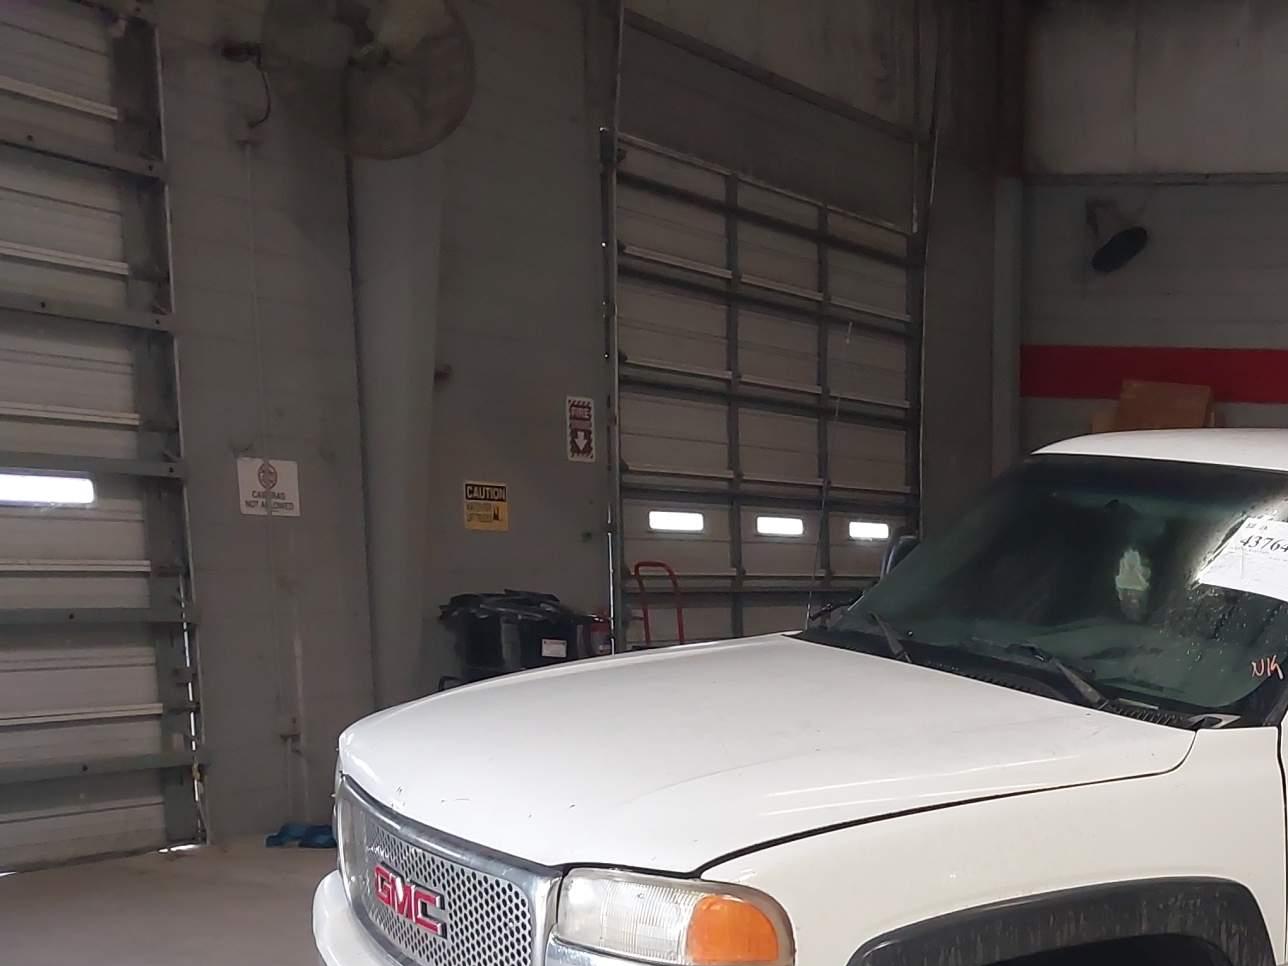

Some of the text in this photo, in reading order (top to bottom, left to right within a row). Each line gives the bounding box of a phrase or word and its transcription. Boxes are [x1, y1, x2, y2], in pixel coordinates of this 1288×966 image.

[252, 490, 286, 500] CAMRAS
[466, 486, 506, 500] CAUTION
[245, 500, 294, 511] NOT AOWED
[375, 865, 442, 936] GMC
